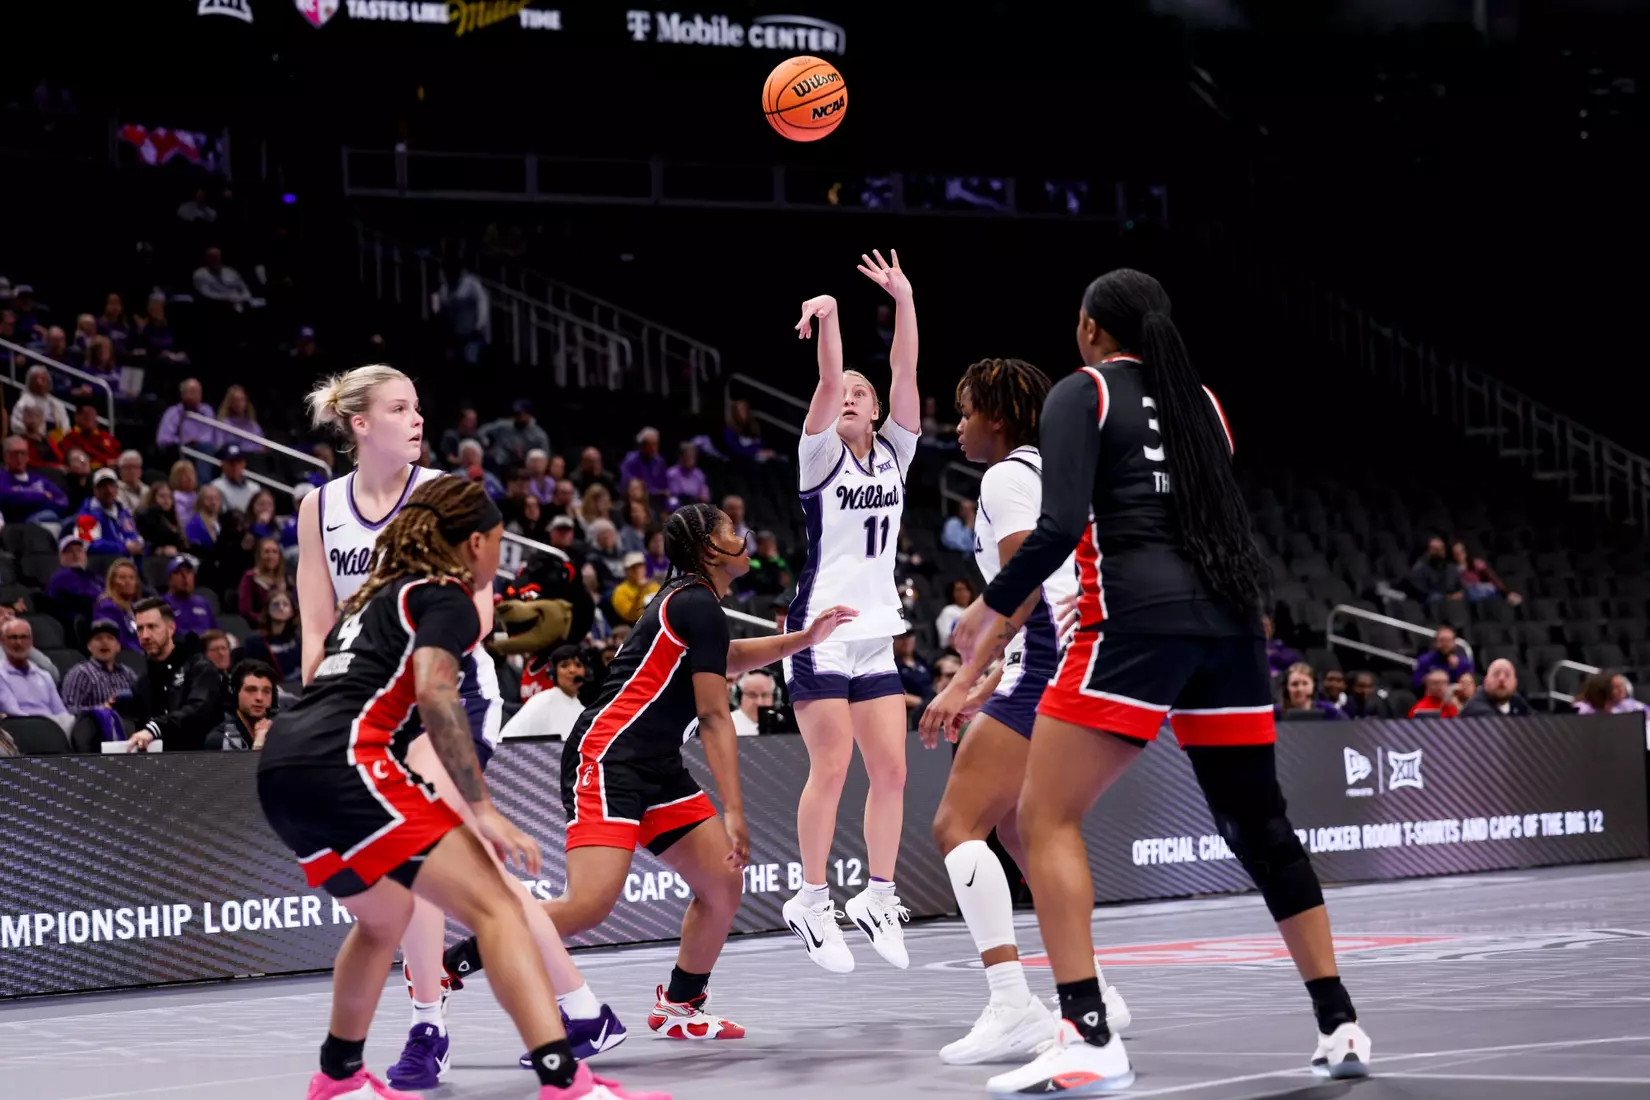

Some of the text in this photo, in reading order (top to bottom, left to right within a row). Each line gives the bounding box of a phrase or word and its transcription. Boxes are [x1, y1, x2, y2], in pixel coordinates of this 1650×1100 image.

[345, 0, 410, 21] TASTES
[411, 2, 449, 24] LIKE
[519, 8, 562, 30] TIME
[655, 12, 745, 47] Mobile
[748, 25, 838, 51] CENTER
[791, 72, 841, 98] Wilson
[812, 95, 845, 120] NCAA
[864, 515, 889, 558] 11
[1132, 836, 1197, 866] OFFICIAL
[1309, 825, 1361, 853] LOCKER
[1362, 823, 1401, 849] ROOM
[1403, 819, 1461, 847] T-SHIRTS
[1462, 817, 1488, 842] AND
[1489, 815, 1521, 840] CAPS
[1523, 814, 1539, 838] OF
[1539, 812, 1564, 837] THE
[1565, 811, 1586, 835] BIG
[1588, 809, 1604, 833] 12
[203, 895, 323, 934] LOCKER
[624, 871, 691, 902] CAPS
[834, 858, 862, 887] 12
